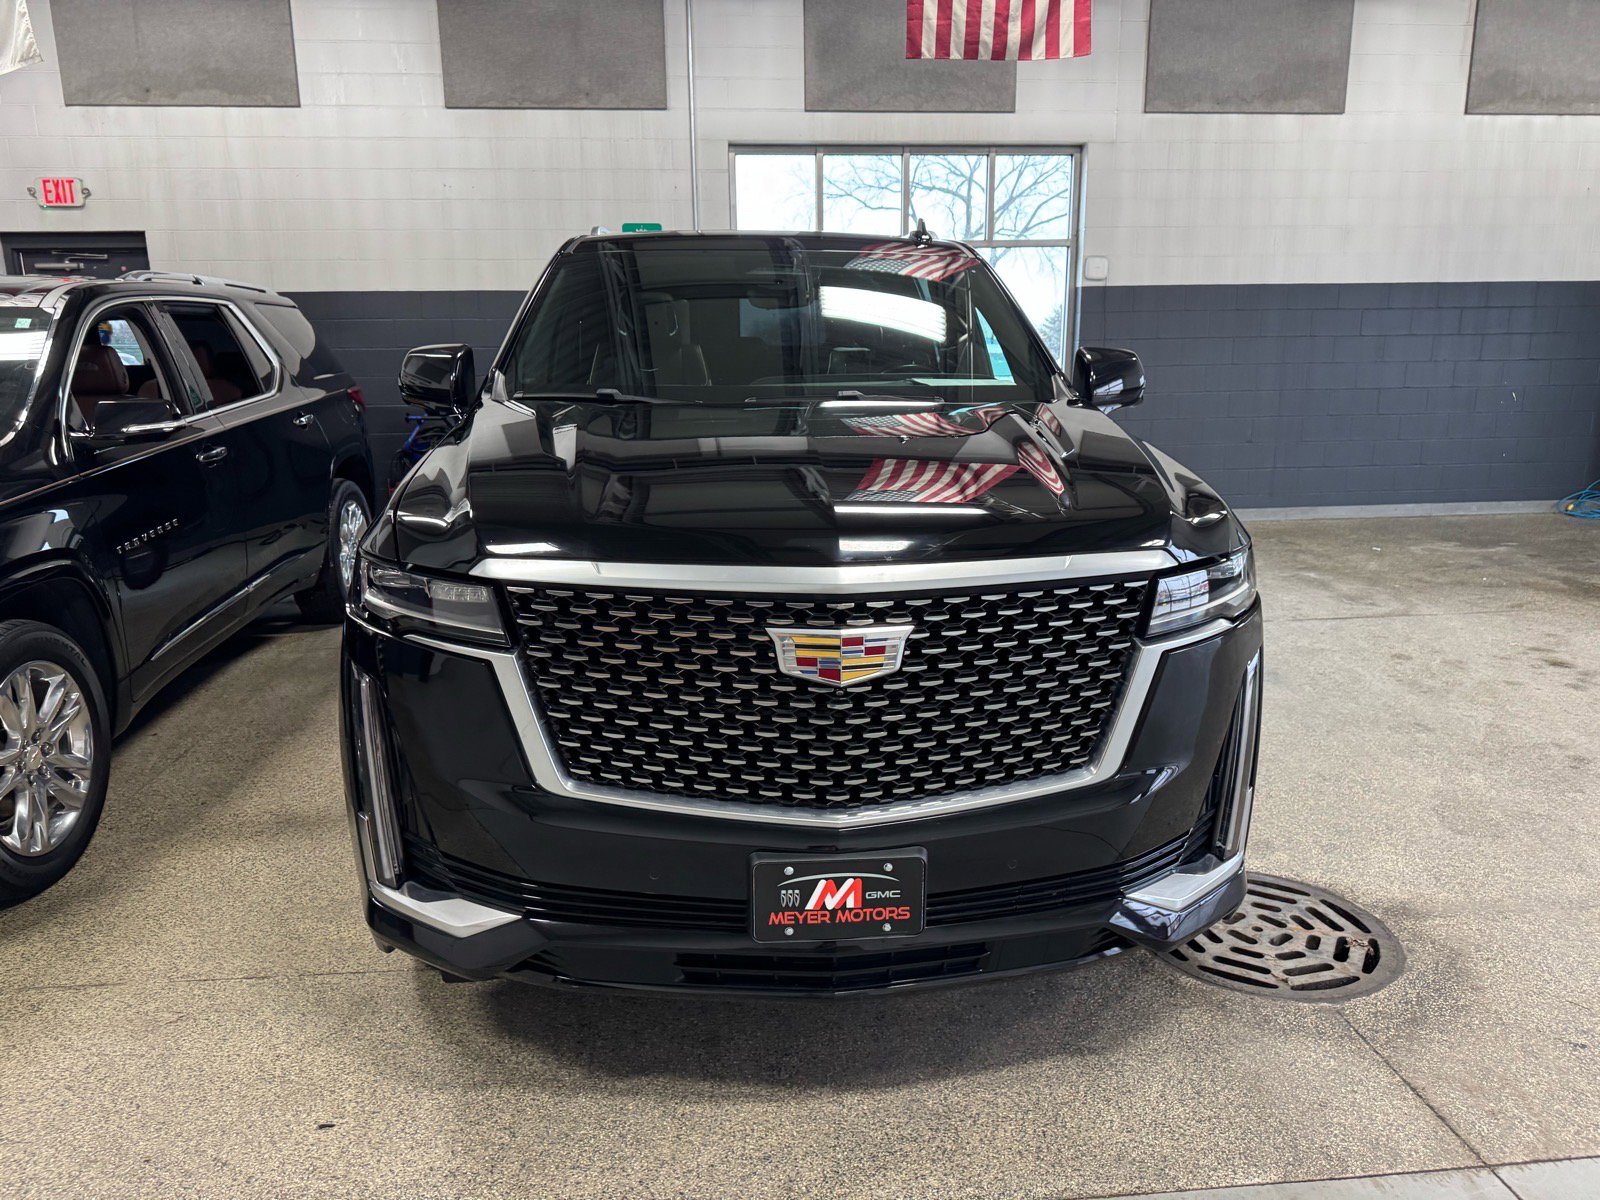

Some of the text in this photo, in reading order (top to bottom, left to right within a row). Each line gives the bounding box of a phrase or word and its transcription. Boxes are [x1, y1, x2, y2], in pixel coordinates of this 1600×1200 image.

[41, 179, 75, 204] EXIT
[116, 518, 178, 554] TRAVERSE
[865, 890, 901, 899] GMC
[768, 907, 911, 925] MEYER MOTORS
